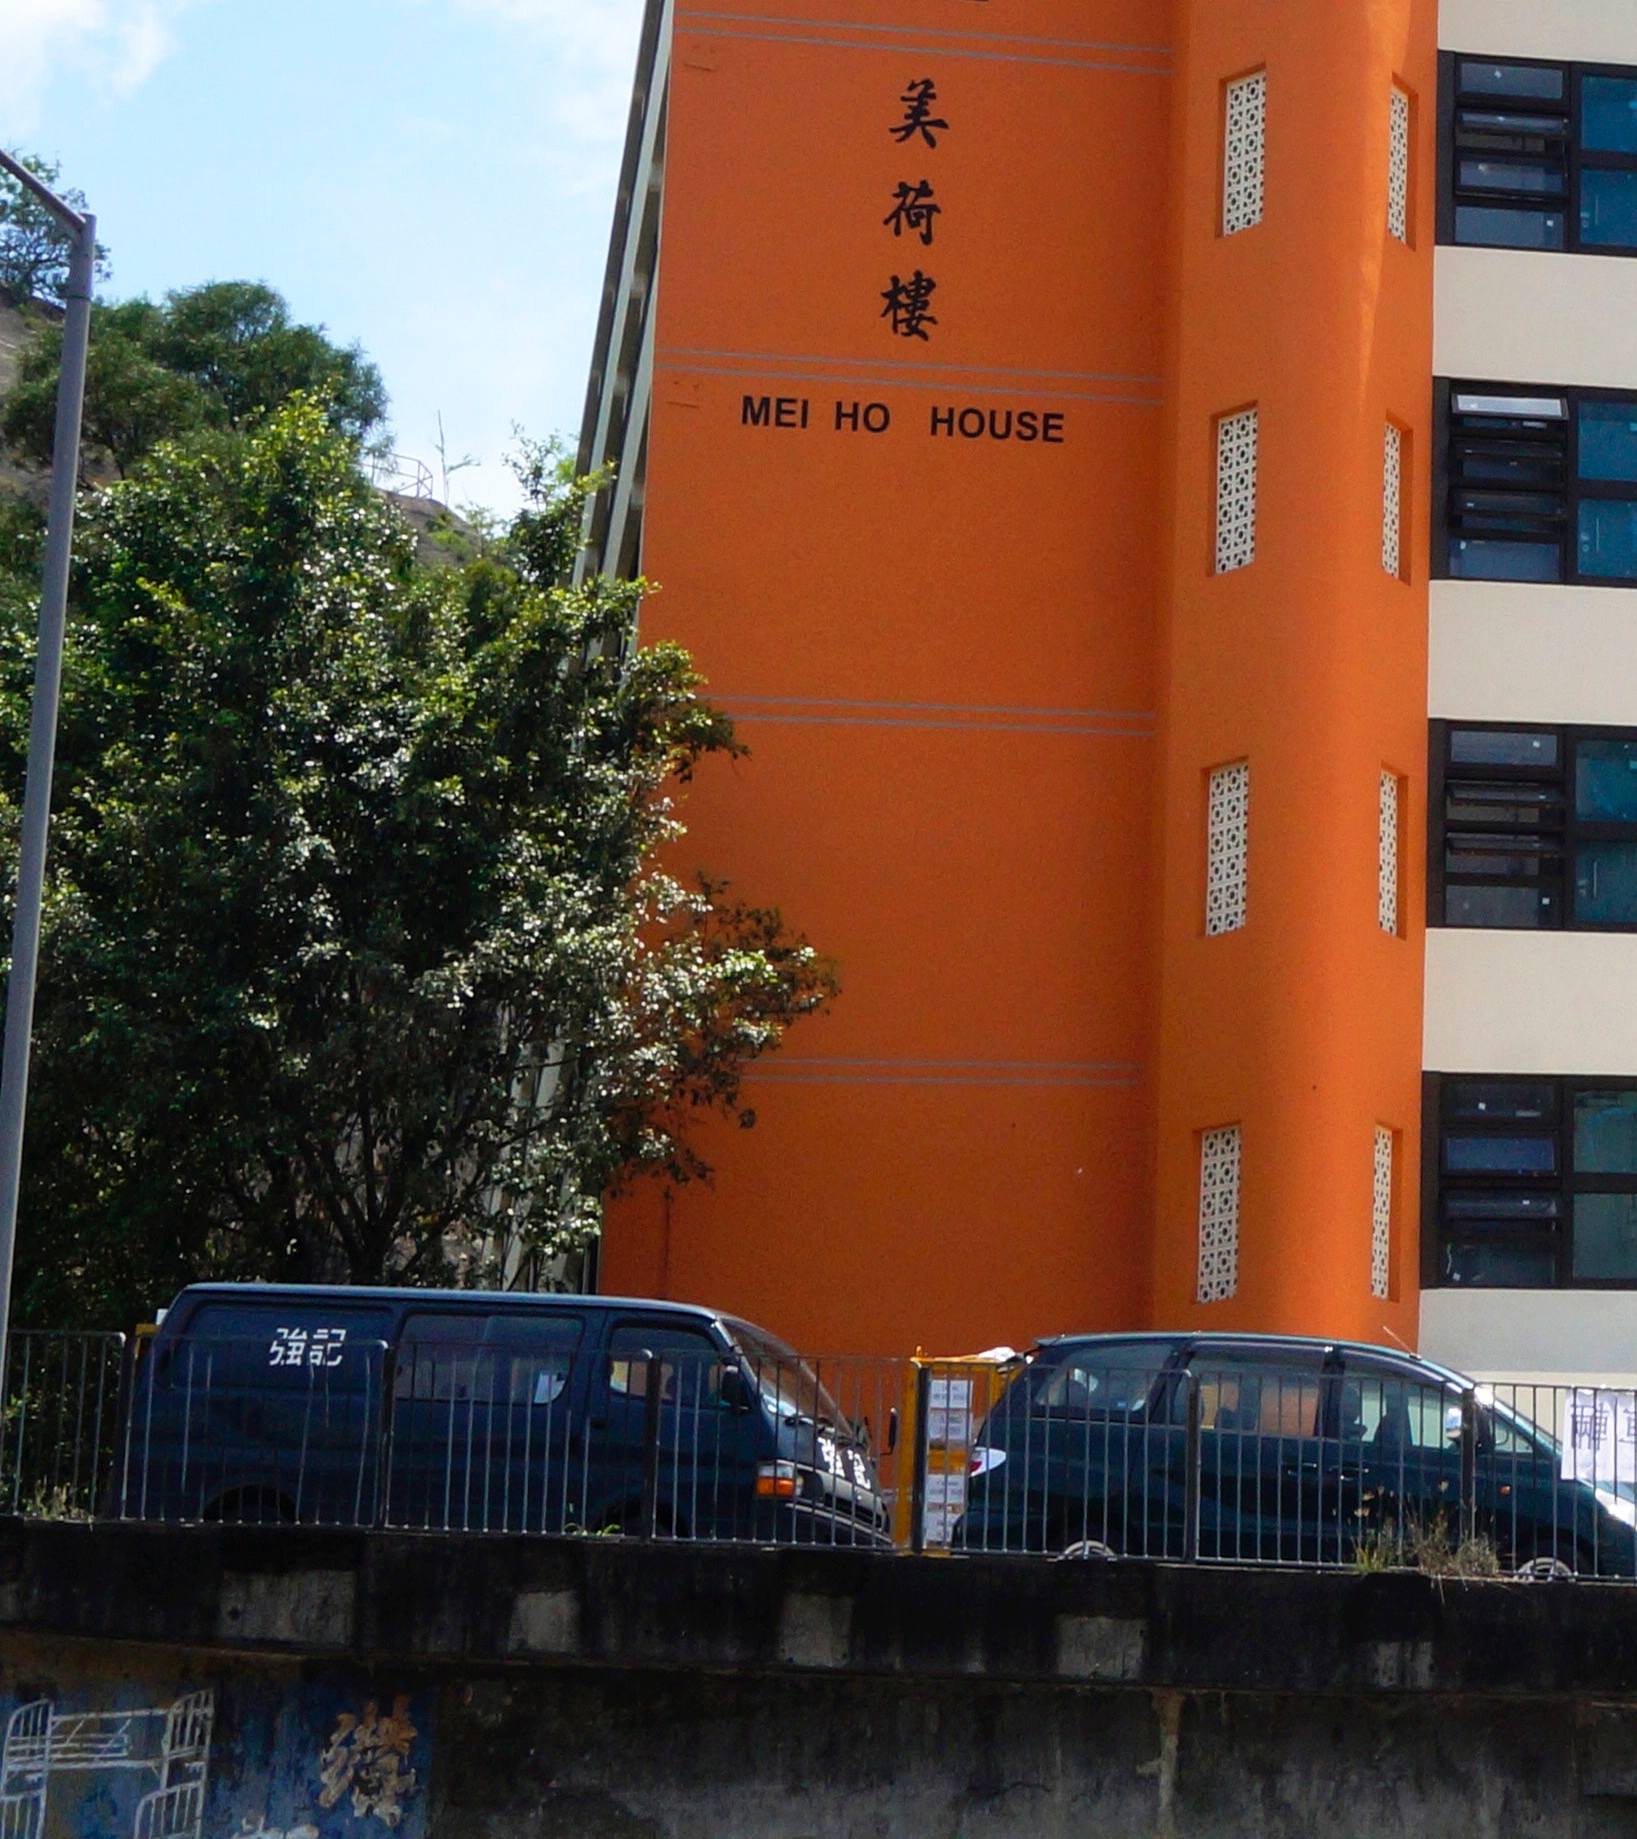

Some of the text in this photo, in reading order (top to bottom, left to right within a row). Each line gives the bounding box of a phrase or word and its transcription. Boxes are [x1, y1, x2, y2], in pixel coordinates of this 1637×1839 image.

[880, 78, 949, 342] 美荷樓
[741, 394, 1065, 444] MEI HO HOUSE
[269, 1327, 347, 1366] 強記
